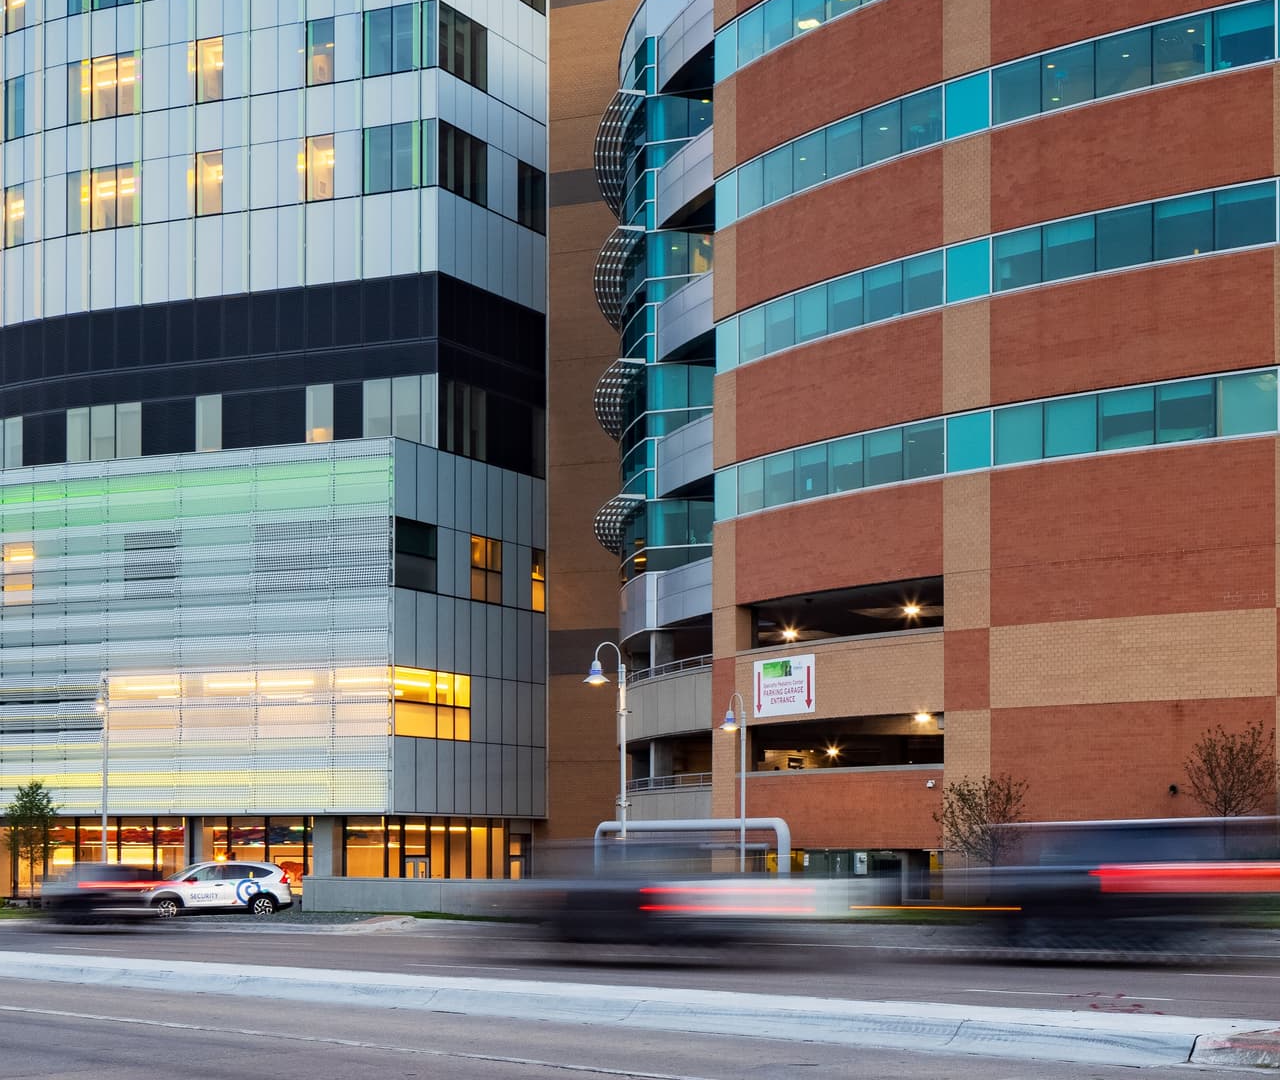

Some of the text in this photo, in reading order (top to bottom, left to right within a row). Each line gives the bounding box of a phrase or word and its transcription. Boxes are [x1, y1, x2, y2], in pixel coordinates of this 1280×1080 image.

[763, 686, 804, 696] PARKING GARAGE
[770, 695, 796, 704] ENTRANCE
